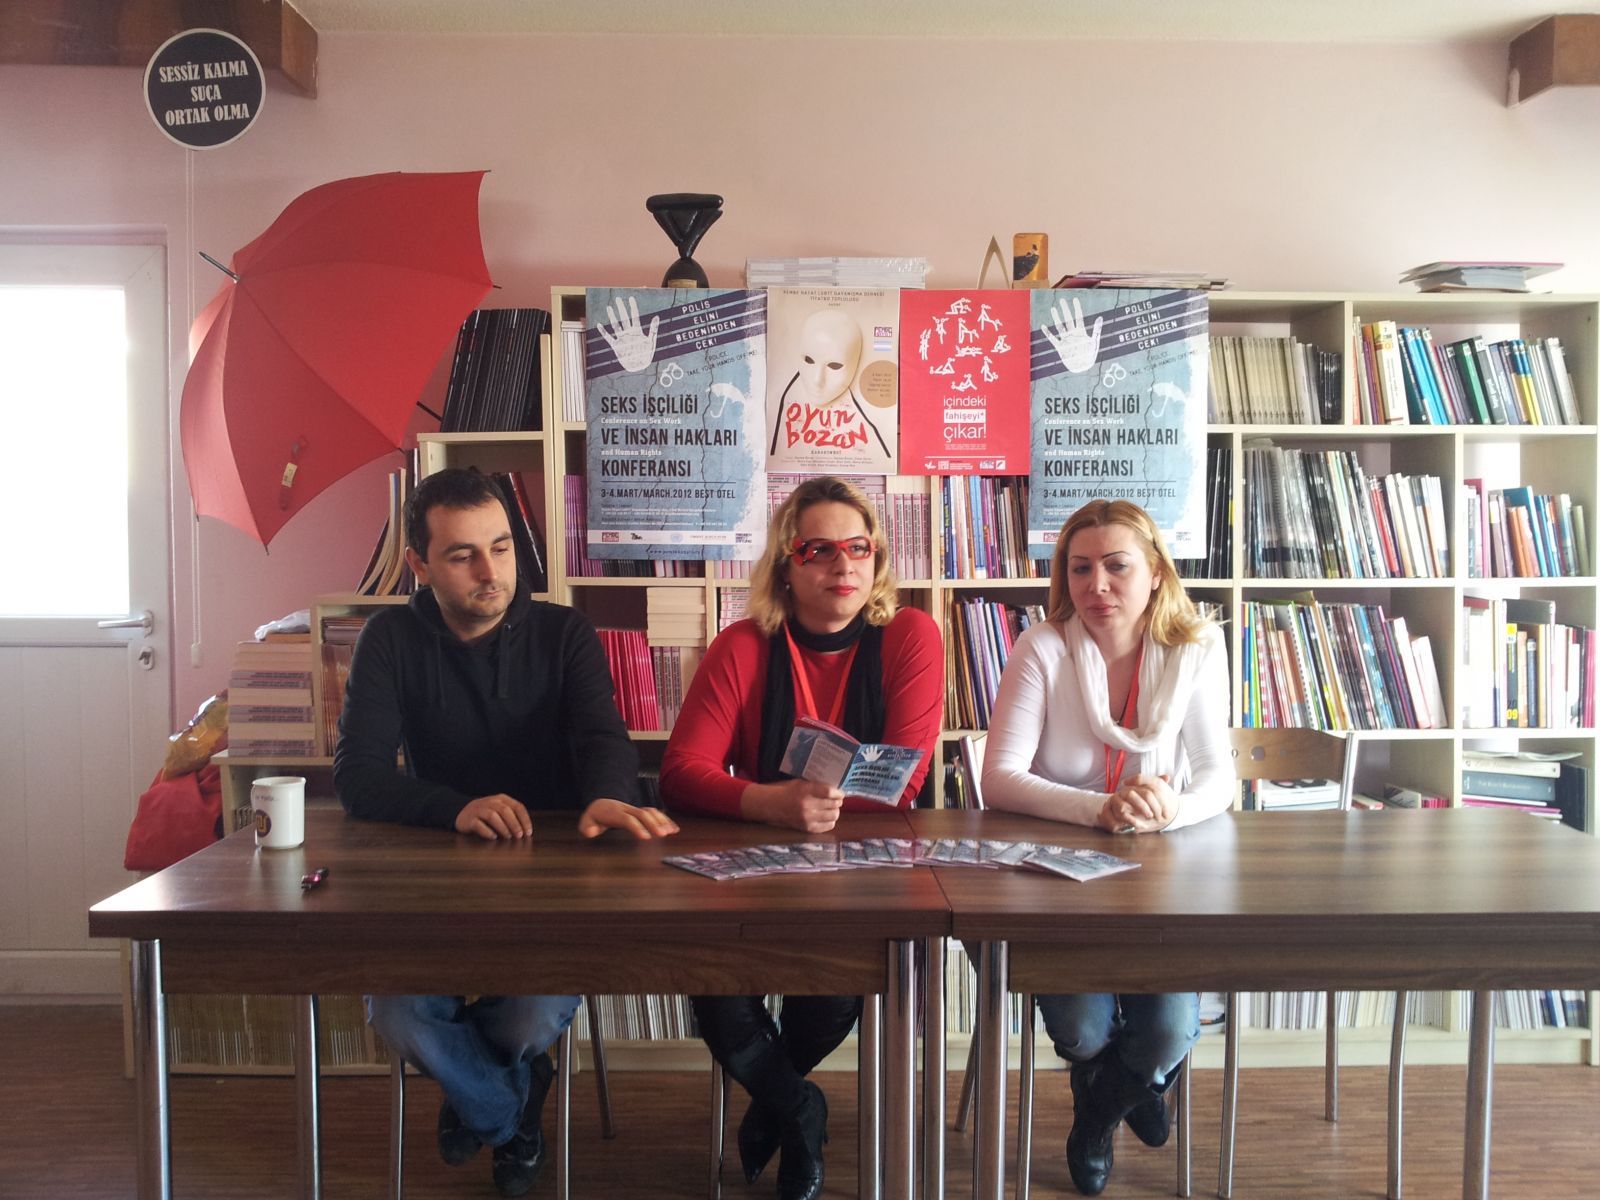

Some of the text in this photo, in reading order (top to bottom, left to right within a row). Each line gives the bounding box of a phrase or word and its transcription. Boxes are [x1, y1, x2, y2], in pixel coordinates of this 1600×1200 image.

[159, 60, 249, 83] SESSİZ KALMA
[190, 84, 222, 103] SUÇA
[165, 103, 250, 126] ORTAK OLMA
[682, 300, 711, 314] POLİS
[1124, 301, 1153, 315] POLİS
[693, 310, 719, 325] ELİNİ
[1135, 311, 1161, 325] ELİNİ
[675, 320, 737, 342] BEDENİMDEN
[1119, 320, 1178, 342] BEDENİMDEN
[601, 394, 698, 418] SEKS İŞÇİLİĞİ
[943, 395, 987, 409] içindeki
[1045, 394, 1140, 418] SEKS İŞÇİLİĞİ
[1106, 417, 1124, 425] Work
[601, 425, 737, 446] VE İNSAN HAKLARI
[943, 423, 987, 443] çıkar!
[1044, 425, 1178, 446] VE İNSAN HAKLARI
[640, 449, 662, 457] Rights
[1083, 449, 1105, 458] Rights
[601, 459, 691, 477] KONFERANSI
[1044, 459, 1133, 477] KONFERANSI
[695, 488, 714, 499] BEST
[717, 488, 736, 499] OTEL
[1136, 488, 1156, 498] BEST
[1158, 488, 1176, 498] OTEL
